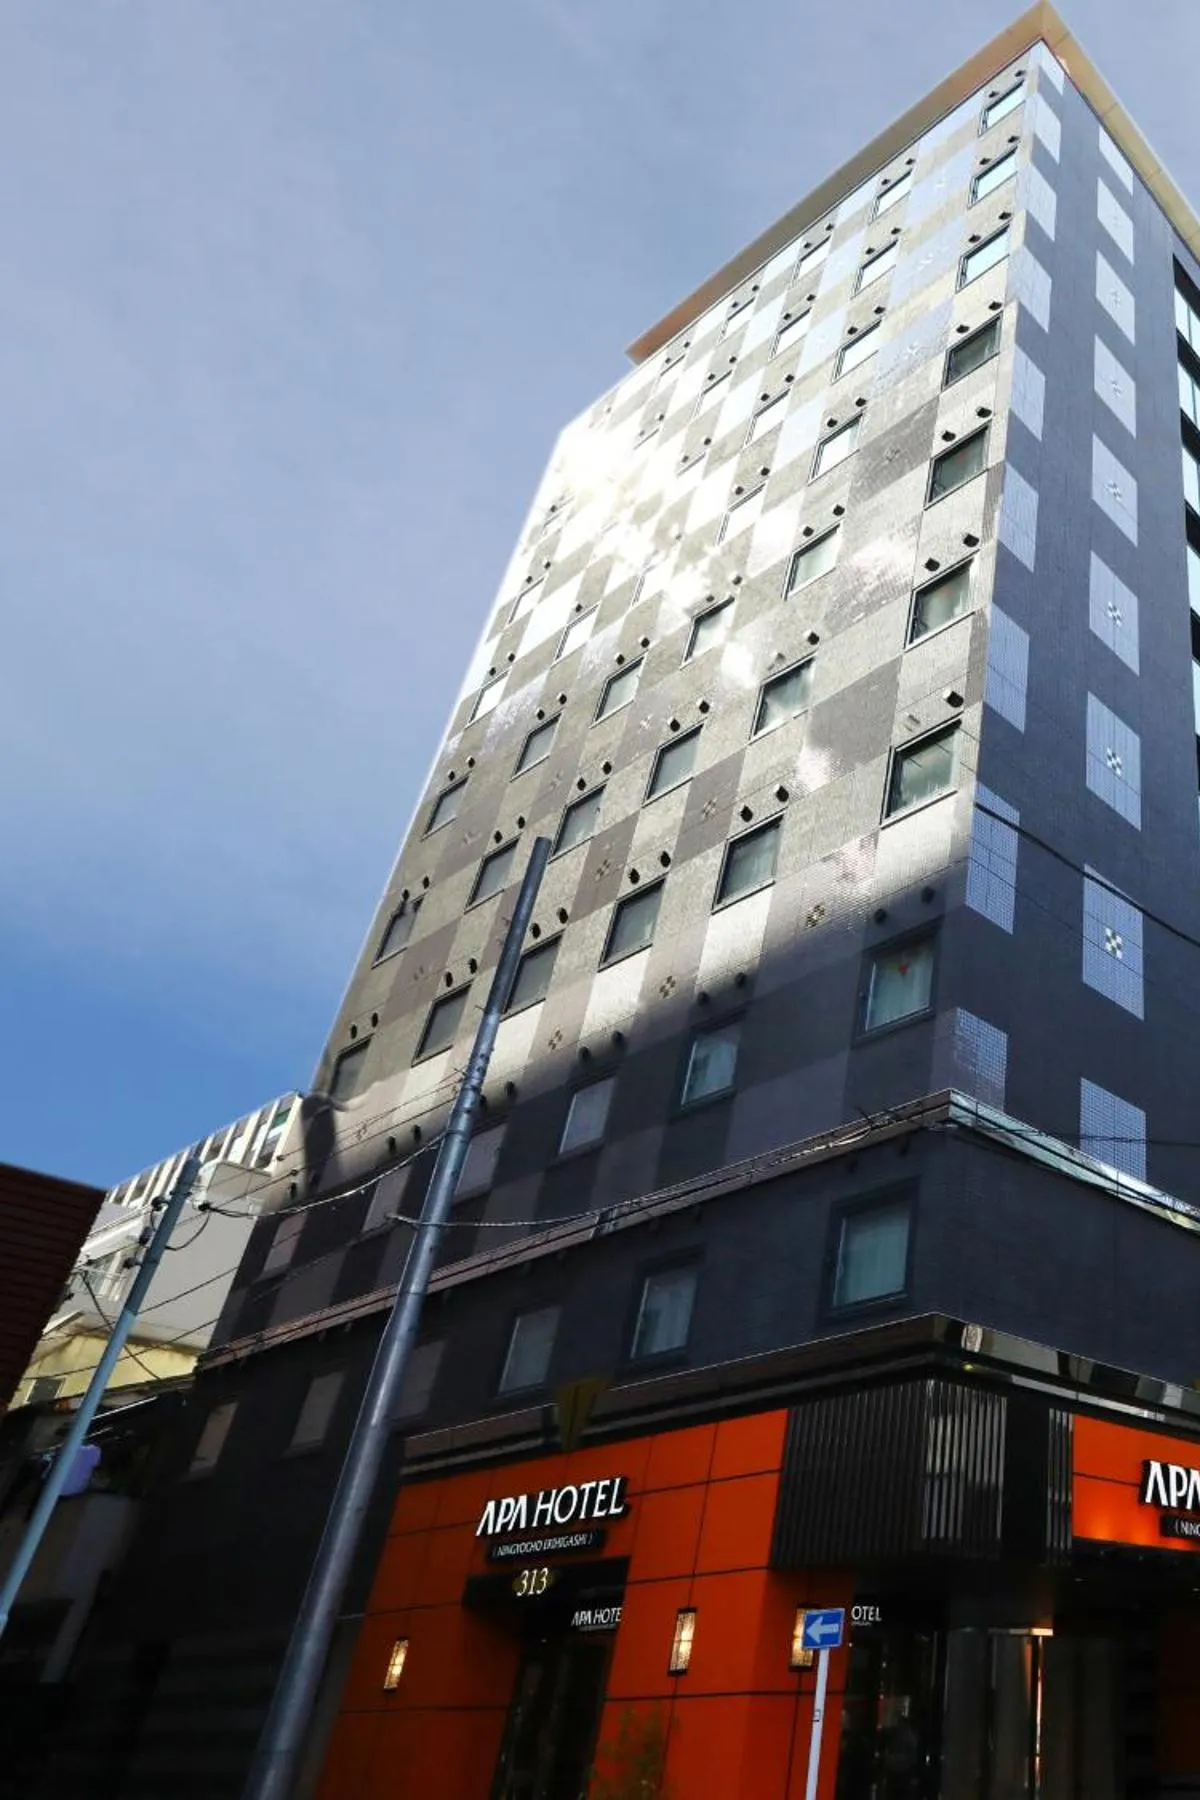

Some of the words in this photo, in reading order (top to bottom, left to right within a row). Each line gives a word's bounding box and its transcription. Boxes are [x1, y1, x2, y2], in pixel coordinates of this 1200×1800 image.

[475, 1494, 527, 1536] APA
[532, 1477, 624, 1528] HOTEL
[516, 1567, 549, 1597] 313
[571, 1610, 592, 1626] APA
[593, 1607, 623, 1624] HOTE
[851, 1605, 882, 1621] OTEL
